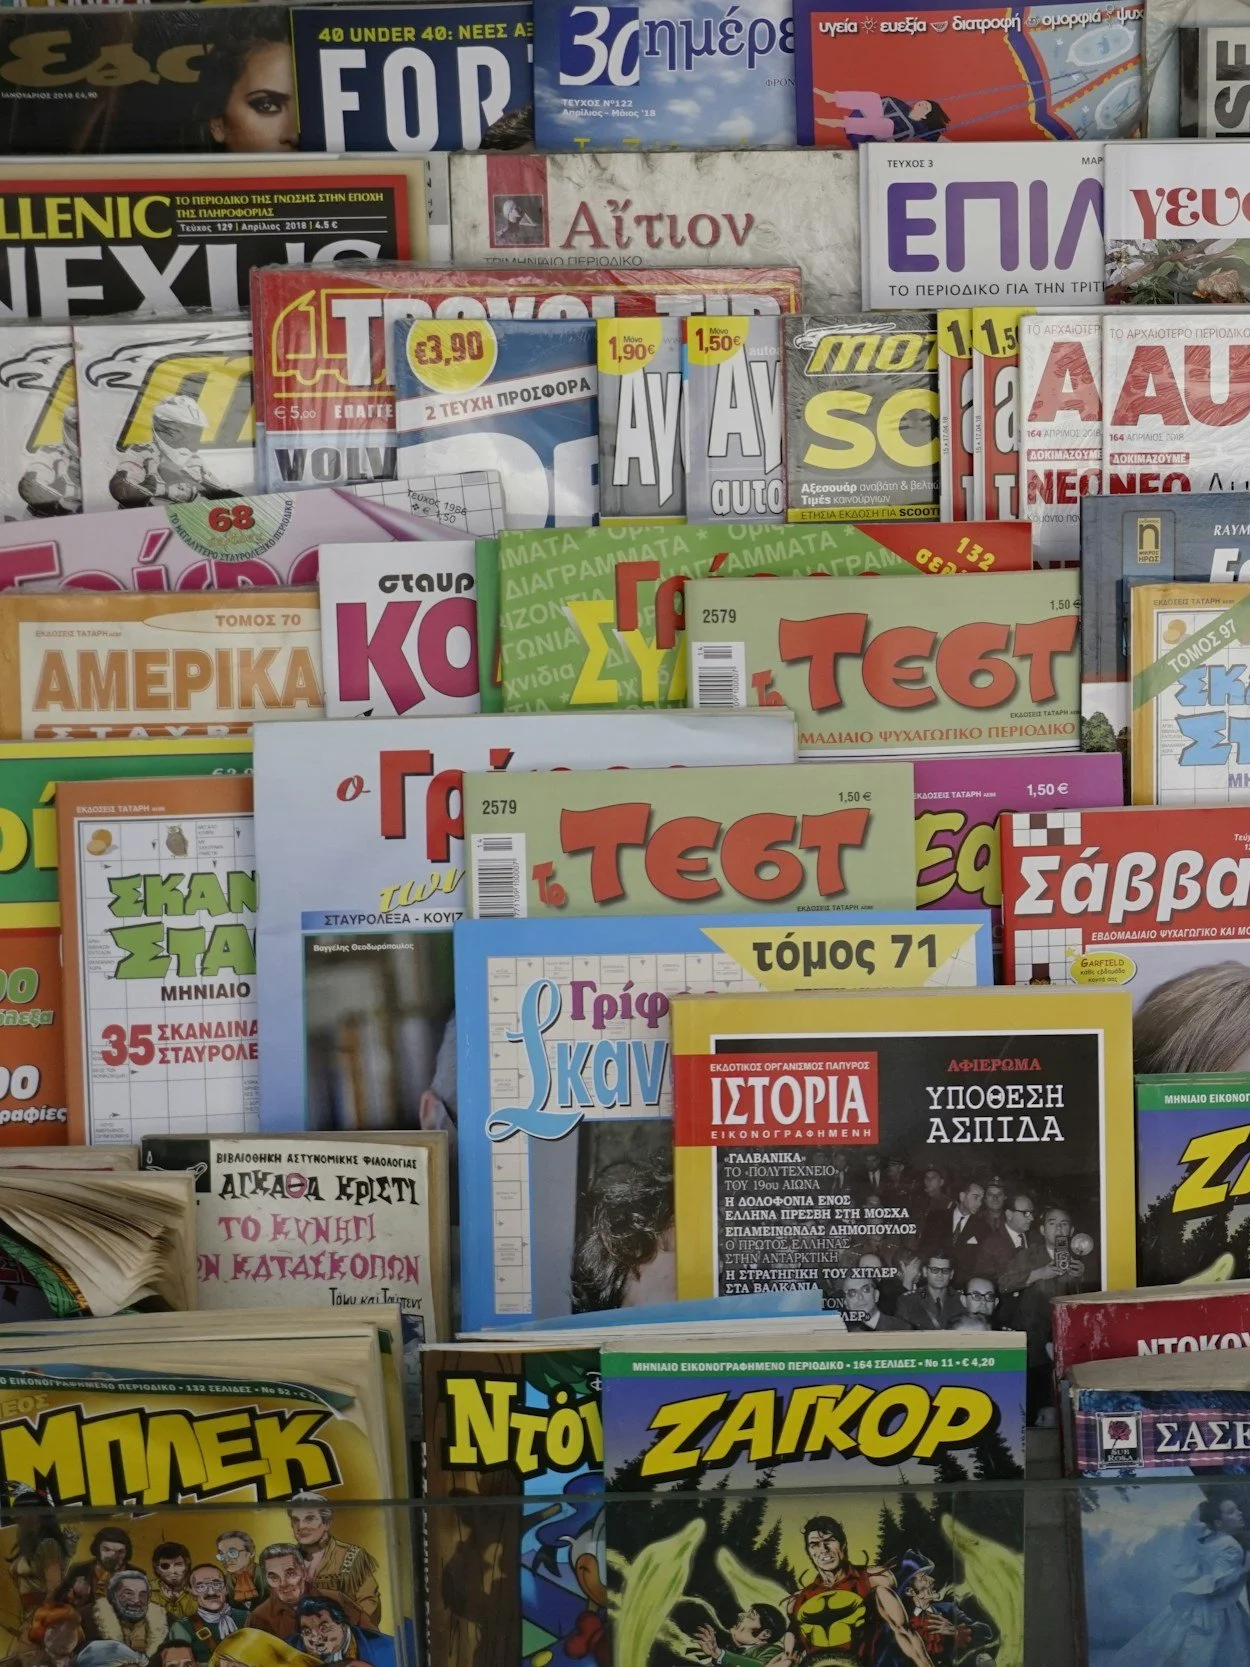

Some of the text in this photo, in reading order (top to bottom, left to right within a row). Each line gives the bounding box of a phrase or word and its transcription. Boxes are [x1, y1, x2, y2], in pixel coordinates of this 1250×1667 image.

[880, 10, 1101, 34] ευεξία διατροφή ομορφιά
[319, 24, 507, 42] 40 UNDER ΝΕΕΣ
[320, 46, 533, 152] FOR
[562, 109, 603, 118] Απρίλιος
[887, 159, 925, 168] ΤΕΥΧΟΣ
[193, 192, 384, 205] ΠΕΡΙΟΔΙΚΟ ΤΗΣ ΓΝΩΣΗΣ ΣΤΗΝ ΕΠΟΧΗ
[177, 207, 274, 218] ΤΗΣ ΠΛΗΡΟΦΟΡΙΑΣ
[180, 222, 307, 233] Τεύχος 129 Απρίλιος 2018
[889, 282, 1065, 295] ΤΟ ΠΕΡΙΟΔΙΚΟ ΓΙΑ ΤΗΝ
[440, 377, 591, 418] ΤΕΥΧΗ ΠΡΟΣΦΟΡΑ
[1113, 453, 1186, 464] ΔΟΚΙΜΑΖΟΥΜΕ
[801, 482, 898, 494] Αξεσουάρ αναβάτη
[801, 495, 830, 505] Τιμές
[208, 505, 255, 531] 68
[801, 510, 875, 519] ΕΤΗΣΙΑ ΕΚΔΟΣΗ
[216, 613, 301, 627] ΤΟΜΟΣ 70
[702, 609, 736, 624] 2579
[33, 647, 324, 711] ΑΜΕΡΙΚΑ
[879, 722, 1075, 743] ΨΥΧΑΓΩΓΙΚΟ ΠΕΡΙΟΔΙΚΟ
[482, 800, 516, 816] 2579
[325, 913, 410, 926] ΣΤΑΥΡΟΛΕΞΑ
[1091, 930, 1157, 941] ΕΒΔΟΜΑΔΙΑΙΟ
[1160, 928, 1217, 939] ΨΥΧΑΓΩΓΙΚΟ
[1220, 927, 1235, 937] ΚΑΙ
[314, 941, 413, 952] Βαγγέλης Θεοδωρόπουλος
[753, 932, 876, 976] τόμος
[891, 933, 937, 968] 71
[161, 982, 250, 1000] ΜΗΝΙΑΙΟ
[102, 1025, 155, 1066] 35
[710, 1061, 870, 1072] ΕΚΔΟΤΙΚΟΣ ΟΡΓΑΝΙΣΜΟΣ ΠΑΠΥΡΟΣ
[947, 1057, 1041, 1072] ΑΦΙΕΡΩΜΑ
[711, 1075, 870, 1125] ΙΣΤΟΡΙΑ
[926, 1084, 1065, 1110] ΥΠΟΘΕΣΗ
[711, 1129, 872, 1139] ΕΙΚΟΝΟΓΡΑΦΗΜΕΝΗ
[926, 1115, 1065, 1144] ΑΣΠΙΔΑ
[216, 1152, 418, 1169] ΒΙΒΛΙΟΘΗΚΗ ΑΣΤΥΝΟΜΙΚΗΣ ΦΙΛΟΛΟΓΙΑΣ
[724, 1166, 741, 1178] ΤΟ
[219, 1169, 420, 1205] ΑΓΚΑΘΑ ΚΡΙΣΤΙ
[724, 1179, 820, 1191] ΤΟΥ 19ου ΑΙΩΝΑ
[738, 1195, 850, 1207] ΔΟΛΟΦΟΝΙΑ ΕΝΟΣ
[725, 1206, 909, 1221] ΕΛΛΗΝΑ ΠΡΕΣΒΗ ΣΤΗ ΜΟΣΧΑ
[217, 1212, 376, 1244] ΤΟ ΚΥΝΗΓΙ
[725, 1223, 916, 1237] ΕΠΑΜΕΙΝΩΝΔΑΣ ΔΗΜΟΠΟΥΛΟΣ
[725, 1251, 839, 1264] ΣΤΗΝ ΑΝΤΑΡΚΤΙΚΗ
[232, 1251, 421, 1284] ΚΑΤΑΣΚΟΠΩΝ
[739, 1267, 898, 1280] ΣΤΡΑΤΗΓΙΚΗ ΤΟΥ ΧΙΤΛΕΡ
[633, 1360, 786, 1372] ΜΗΝΙΑΙΟ ΕΙΚΟΝΟΓΡΑΦΗΜΕΝΟ
[118, 1383, 251, 1394] ΠΕΡΙΟΔΙΚΟ 132 ΣΕΛΙΔΕΣ
